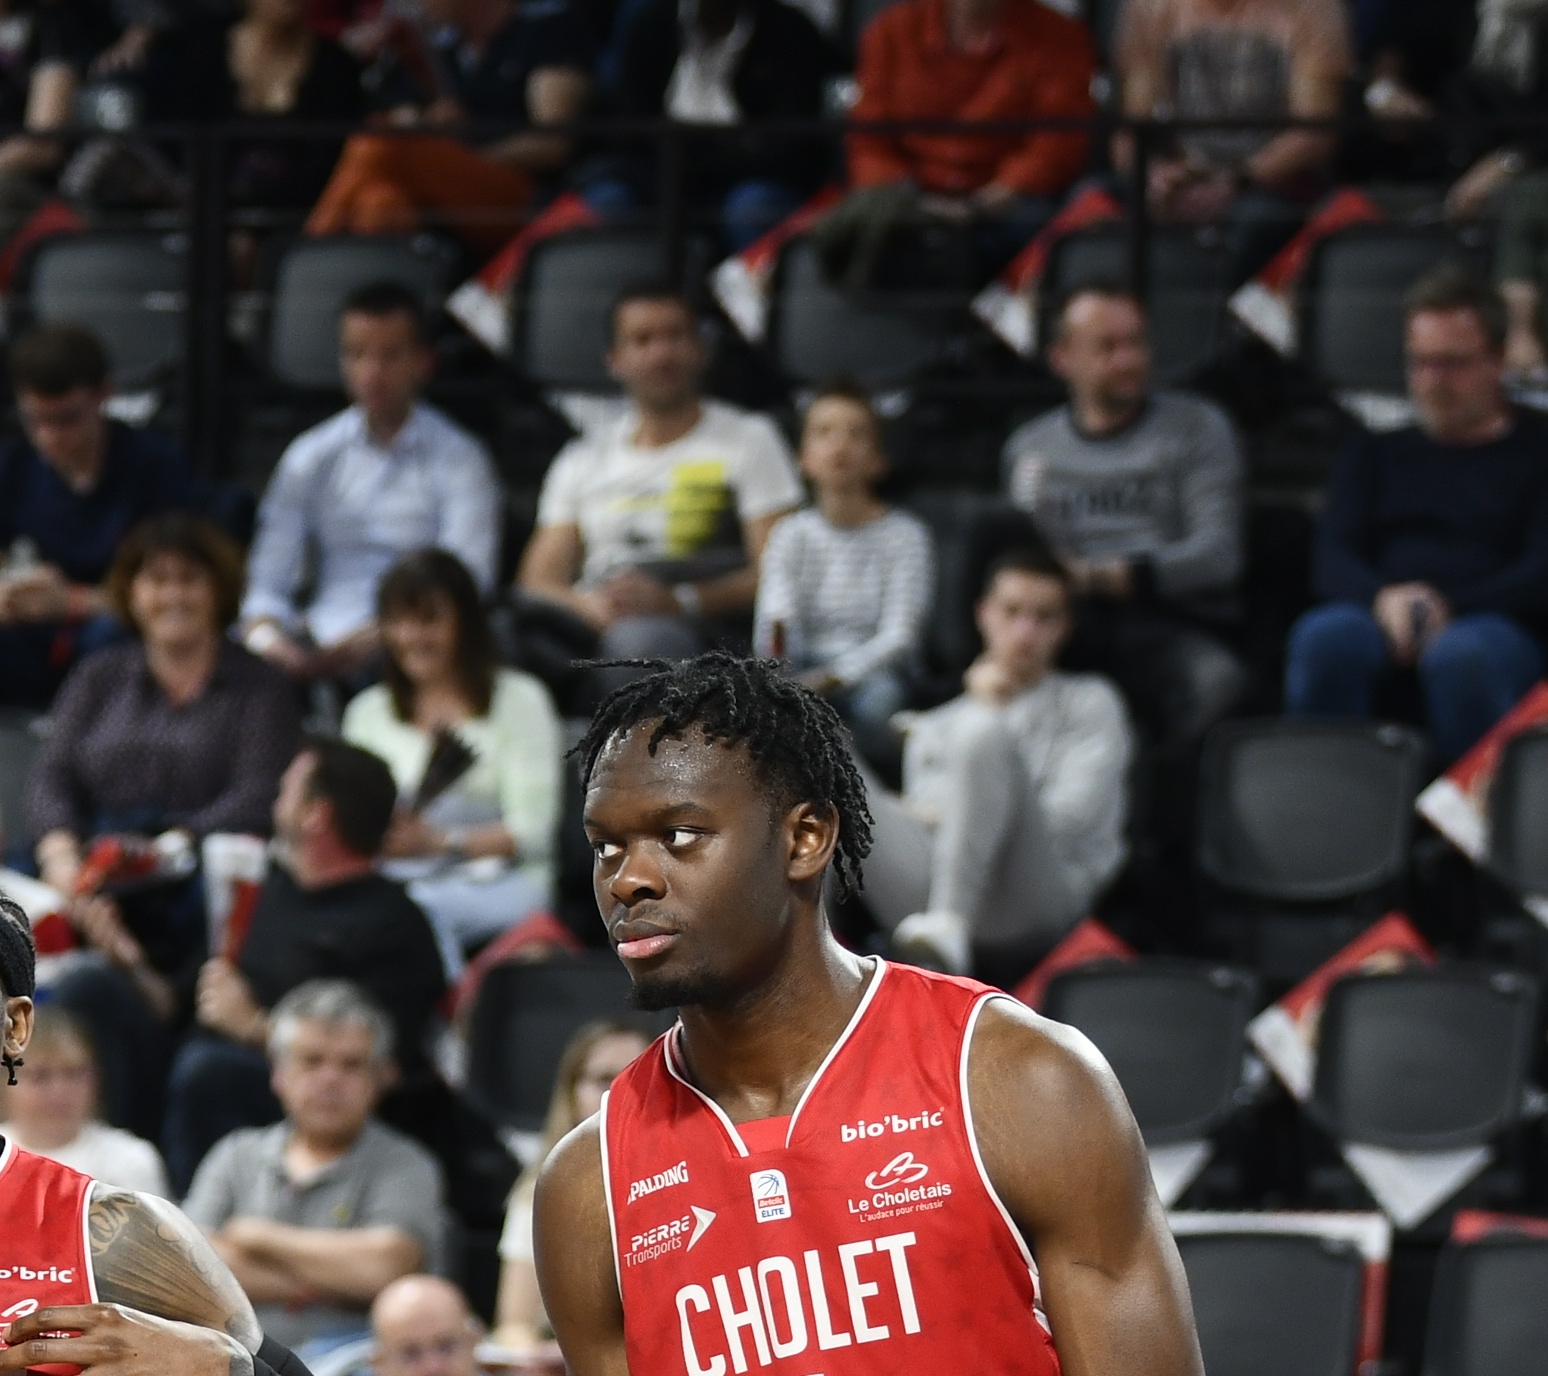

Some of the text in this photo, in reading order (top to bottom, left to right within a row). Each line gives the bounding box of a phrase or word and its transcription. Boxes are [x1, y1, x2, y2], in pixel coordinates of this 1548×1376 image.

[626, 1160, 690, 1206] PALDING
[847, 1182, 952, 1214] Le Choletais
[895, 1205, 915, 1217] pour
